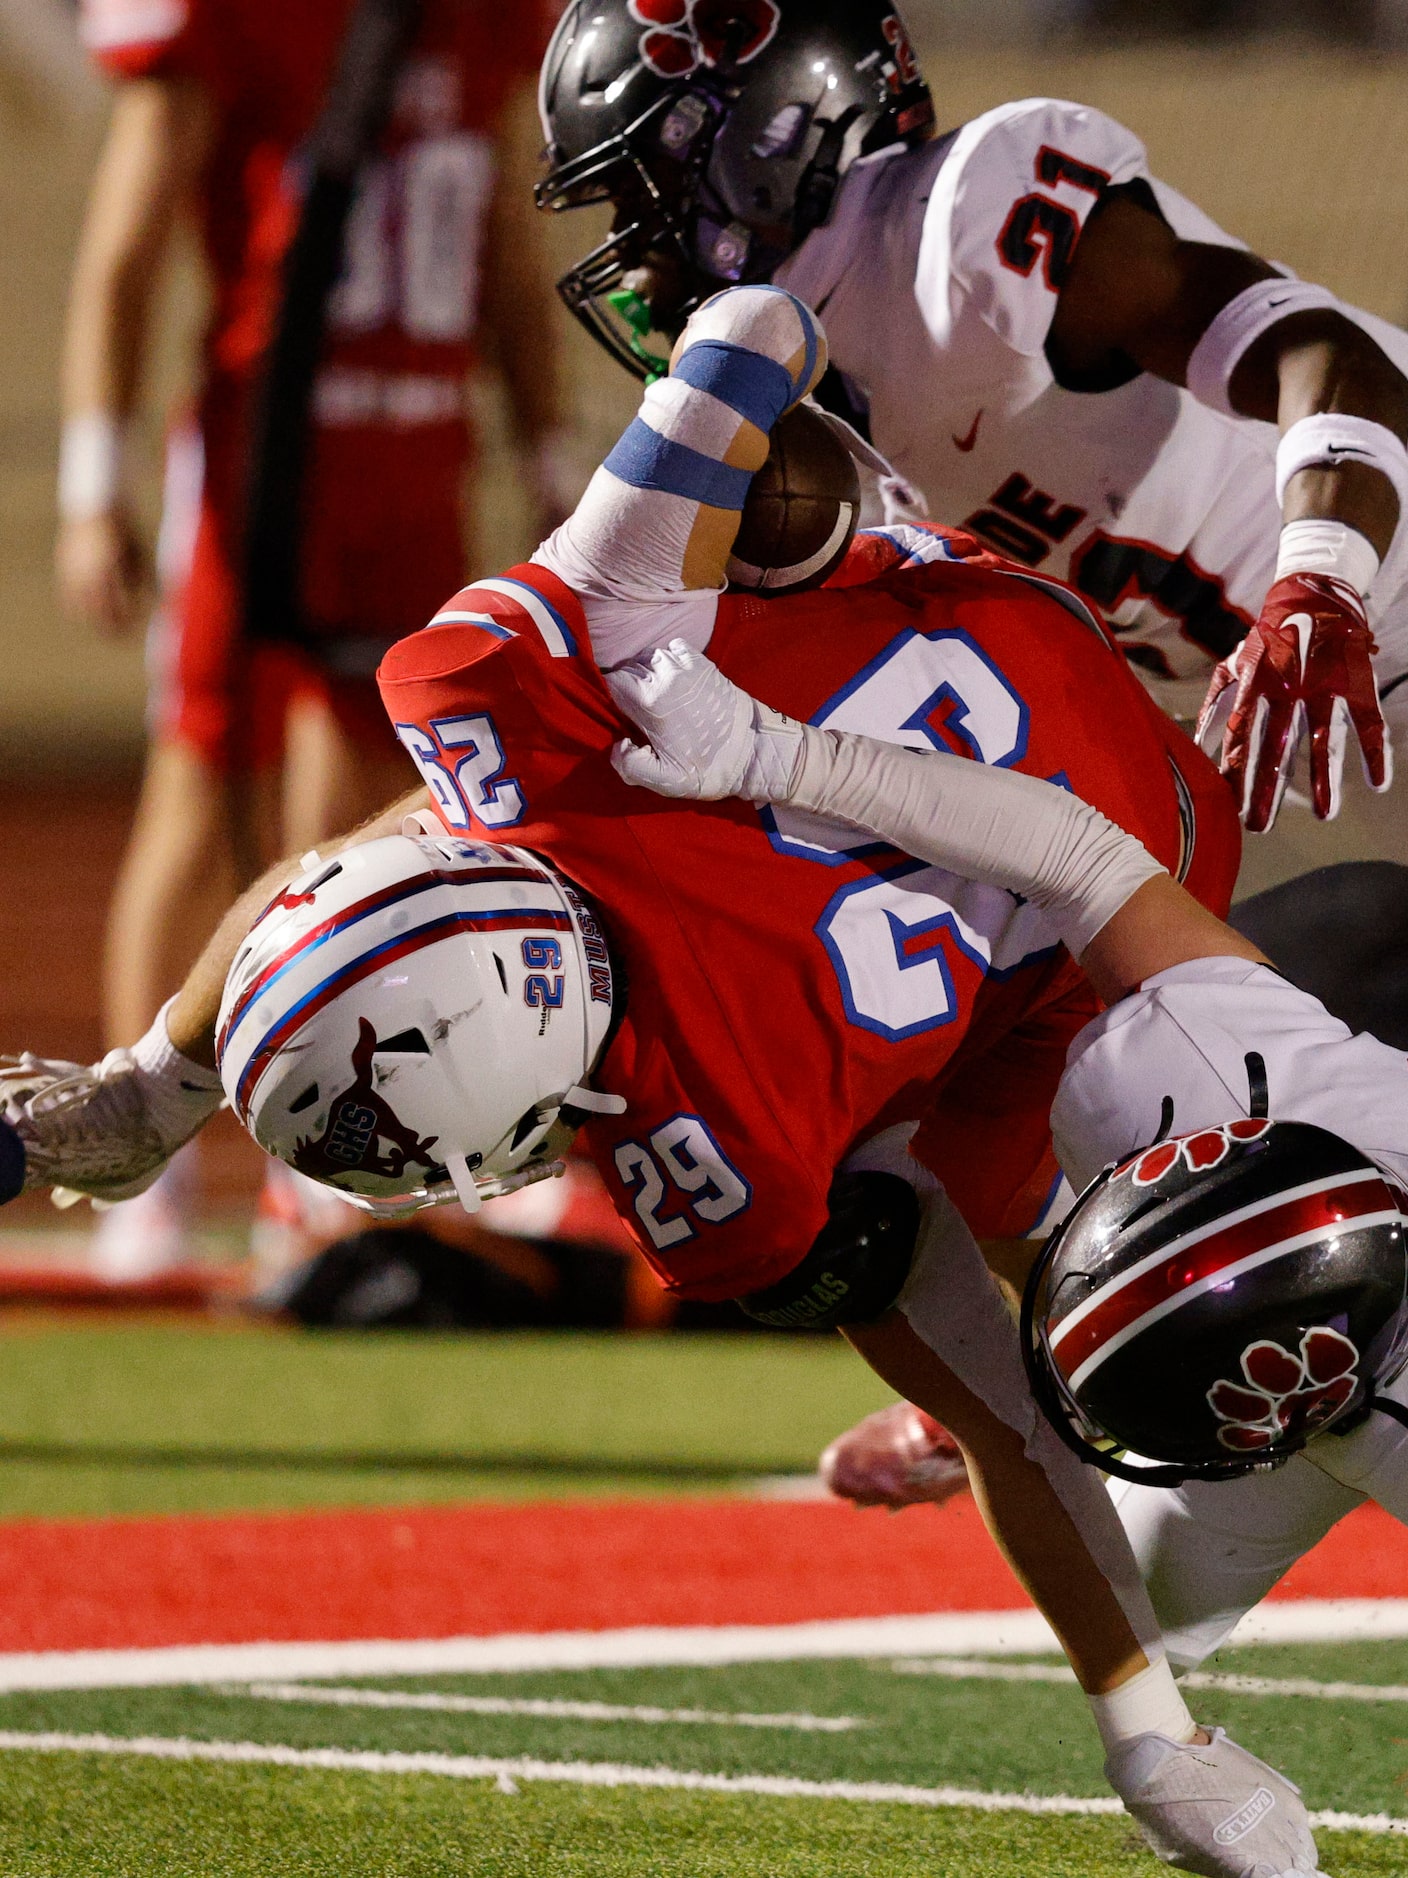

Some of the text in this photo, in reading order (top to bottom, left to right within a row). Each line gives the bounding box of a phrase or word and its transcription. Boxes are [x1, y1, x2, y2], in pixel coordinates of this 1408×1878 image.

[994, 144, 1112, 295] 21
[396, 711, 529, 829] 29
[520, 937, 566, 1009] 29
[613, 1111, 754, 1250] 29
